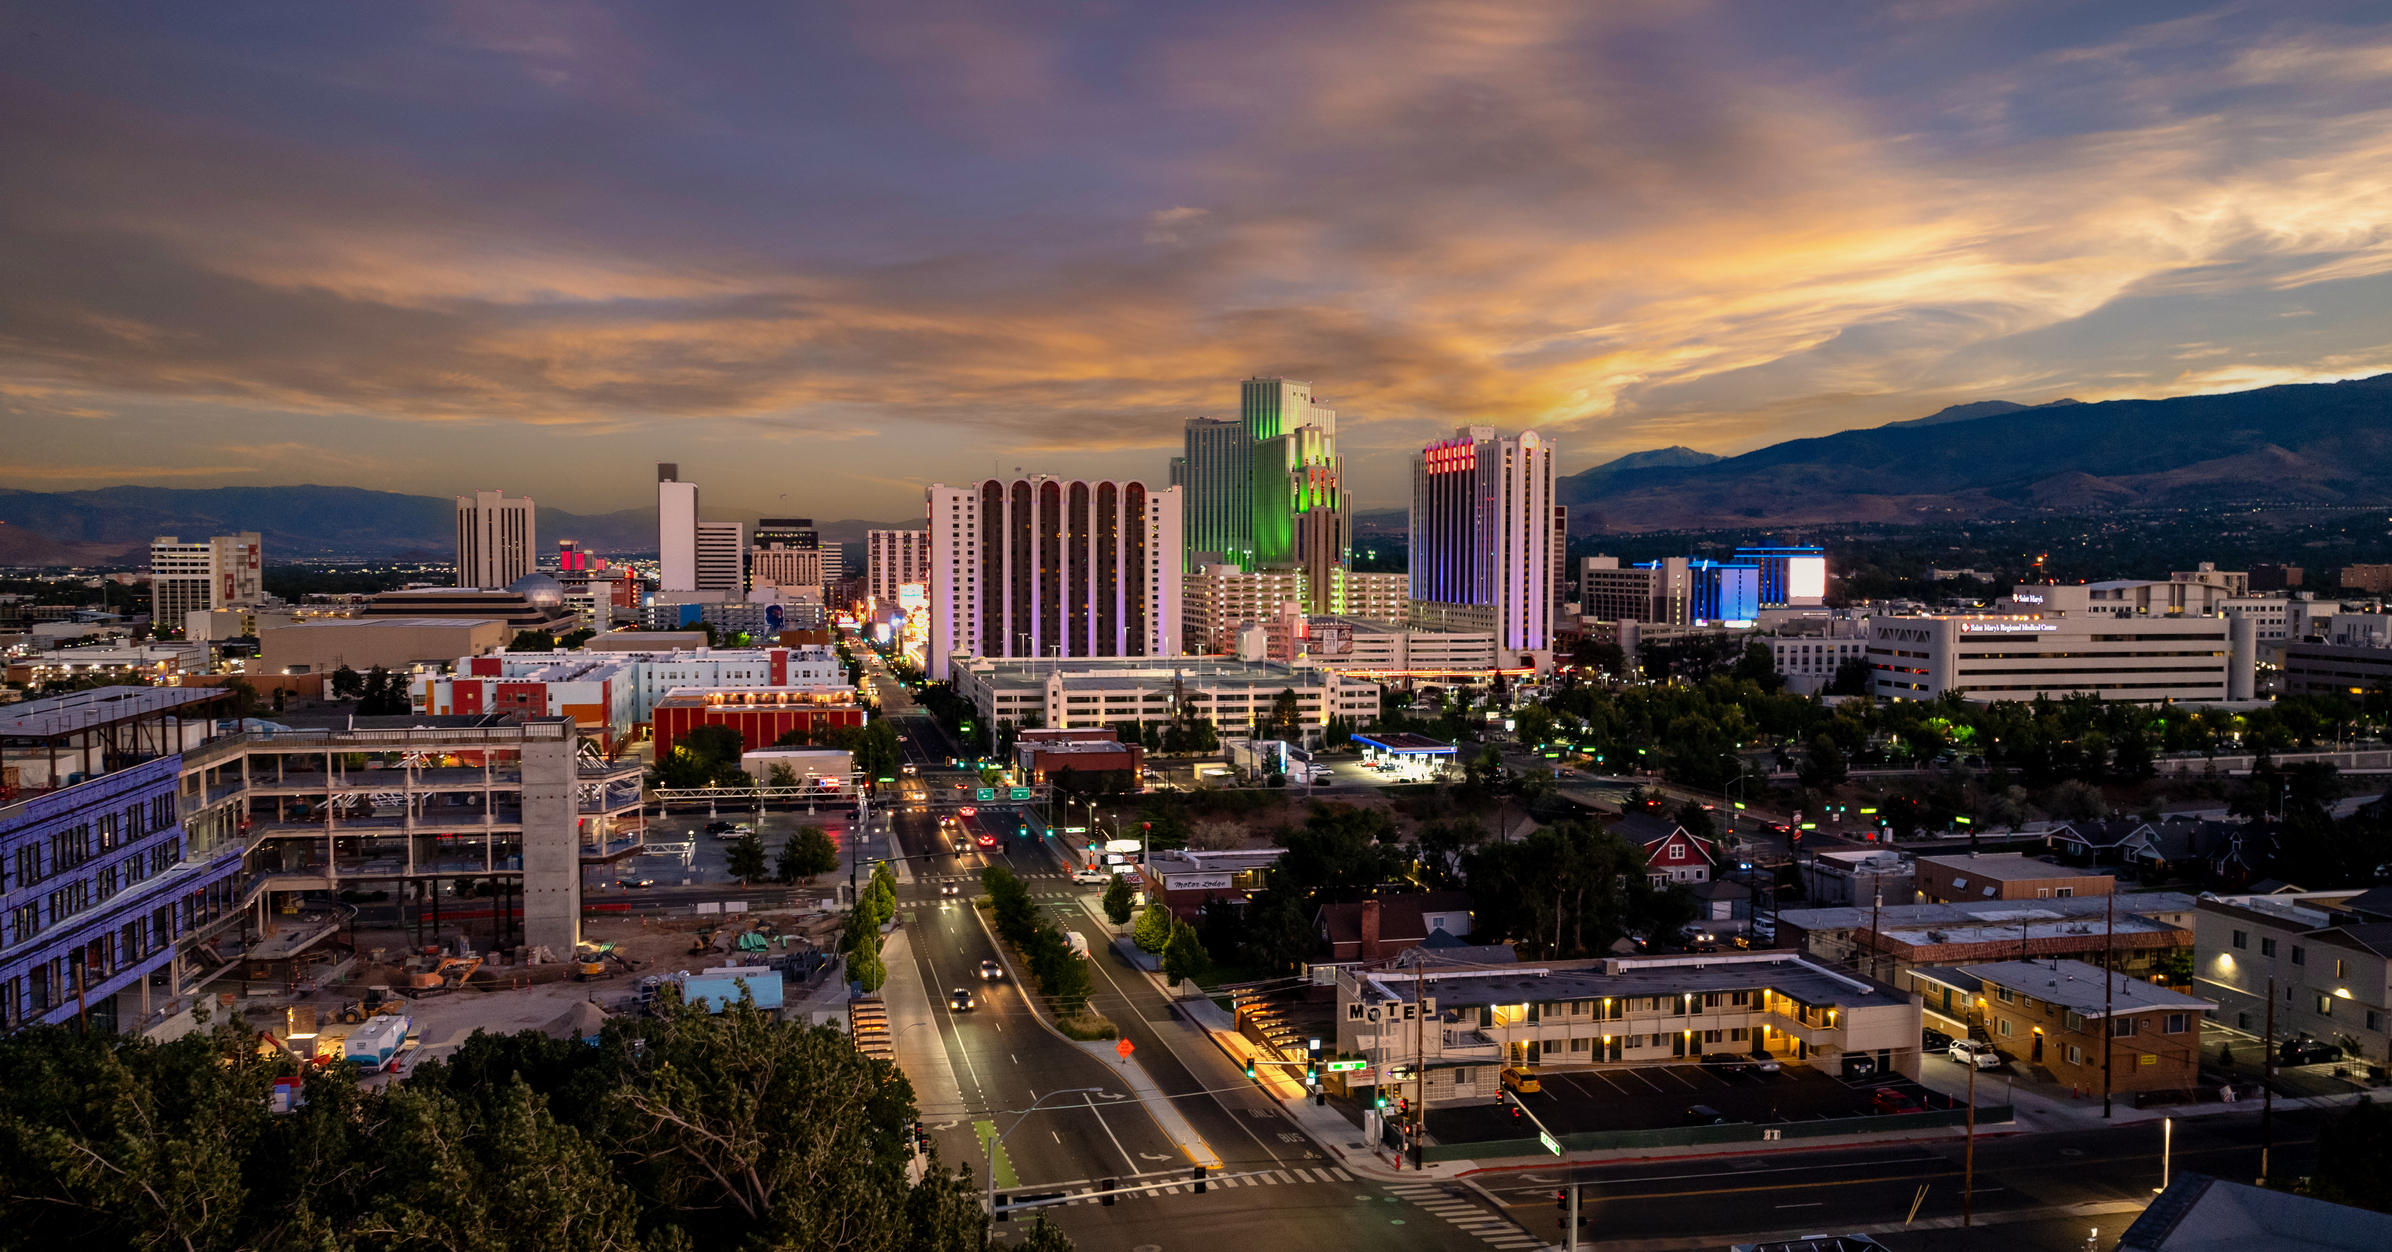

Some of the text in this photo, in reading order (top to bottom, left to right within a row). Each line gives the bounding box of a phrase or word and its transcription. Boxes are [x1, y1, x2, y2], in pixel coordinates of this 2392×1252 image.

[2019, 594, 2029, 603] Saint
[1971, 624, 1983, 632] Saint
[1984, 624, 1999, 633] Mary's
[2000, 624, 2021, 633] Regional
[1174, 880, 1226, 889] Motor Lodge
[1349, 1000, 1433, 1022] MOTEL
[1248, 1108, 1279, 1119] ONLY
[1276, 1132, 1306, 1143] BUS
